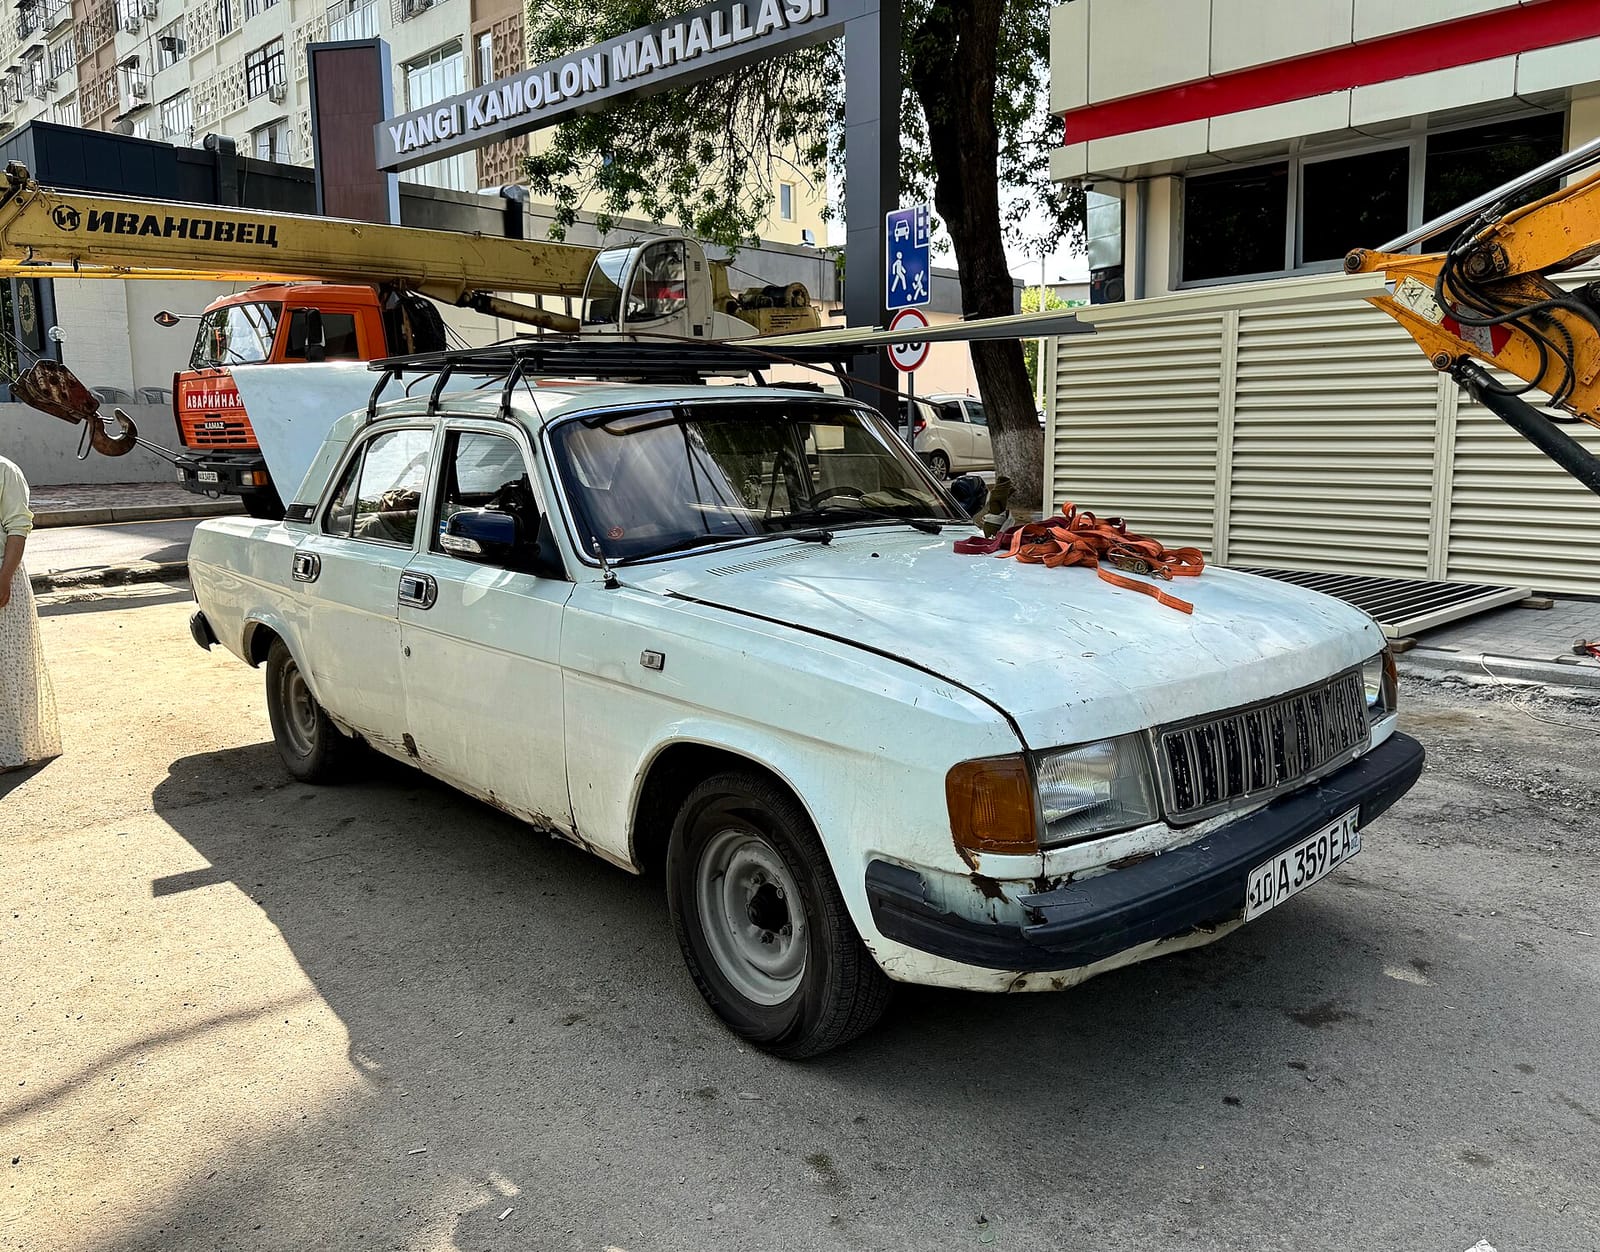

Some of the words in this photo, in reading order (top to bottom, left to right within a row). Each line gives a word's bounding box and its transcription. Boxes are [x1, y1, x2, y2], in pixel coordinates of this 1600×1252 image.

[389, 104, 459, 153] YANGI
[466, 53, 603, 130] KAMOLON
[87, 210, 278, 248] ИВАНОВЕЦ
[187, 391, 242, 409] АВАРИЙНАЯ
